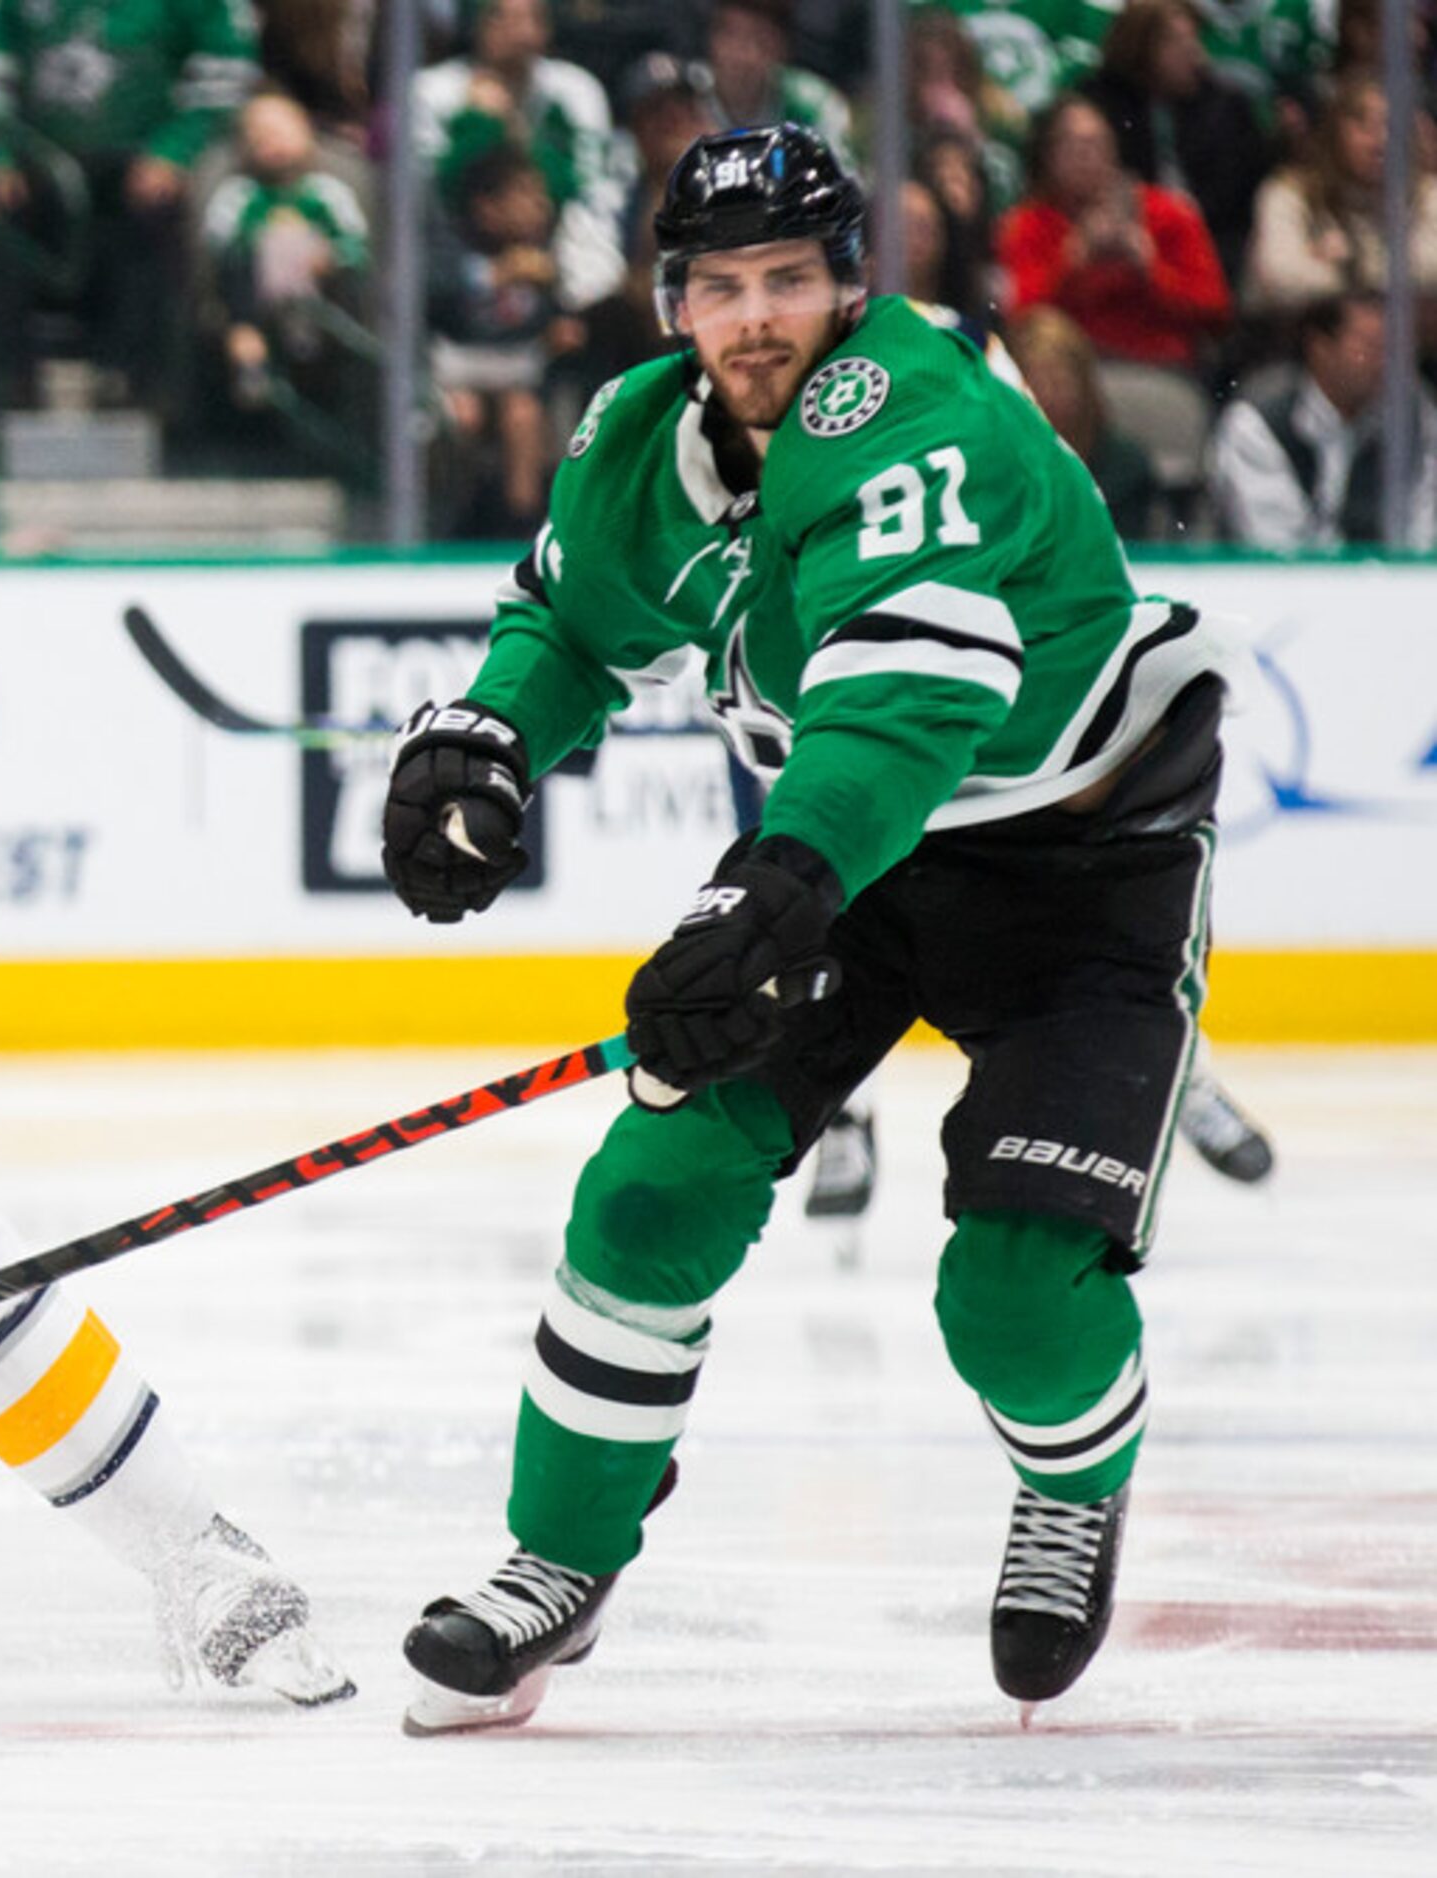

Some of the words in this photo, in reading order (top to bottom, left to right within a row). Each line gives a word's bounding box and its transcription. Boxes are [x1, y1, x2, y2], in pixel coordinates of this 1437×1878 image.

[856, 446, 980, 561] 91
[401, 708, 517, 746] UER
[988, 1136, 1148, 1195] BAUER
